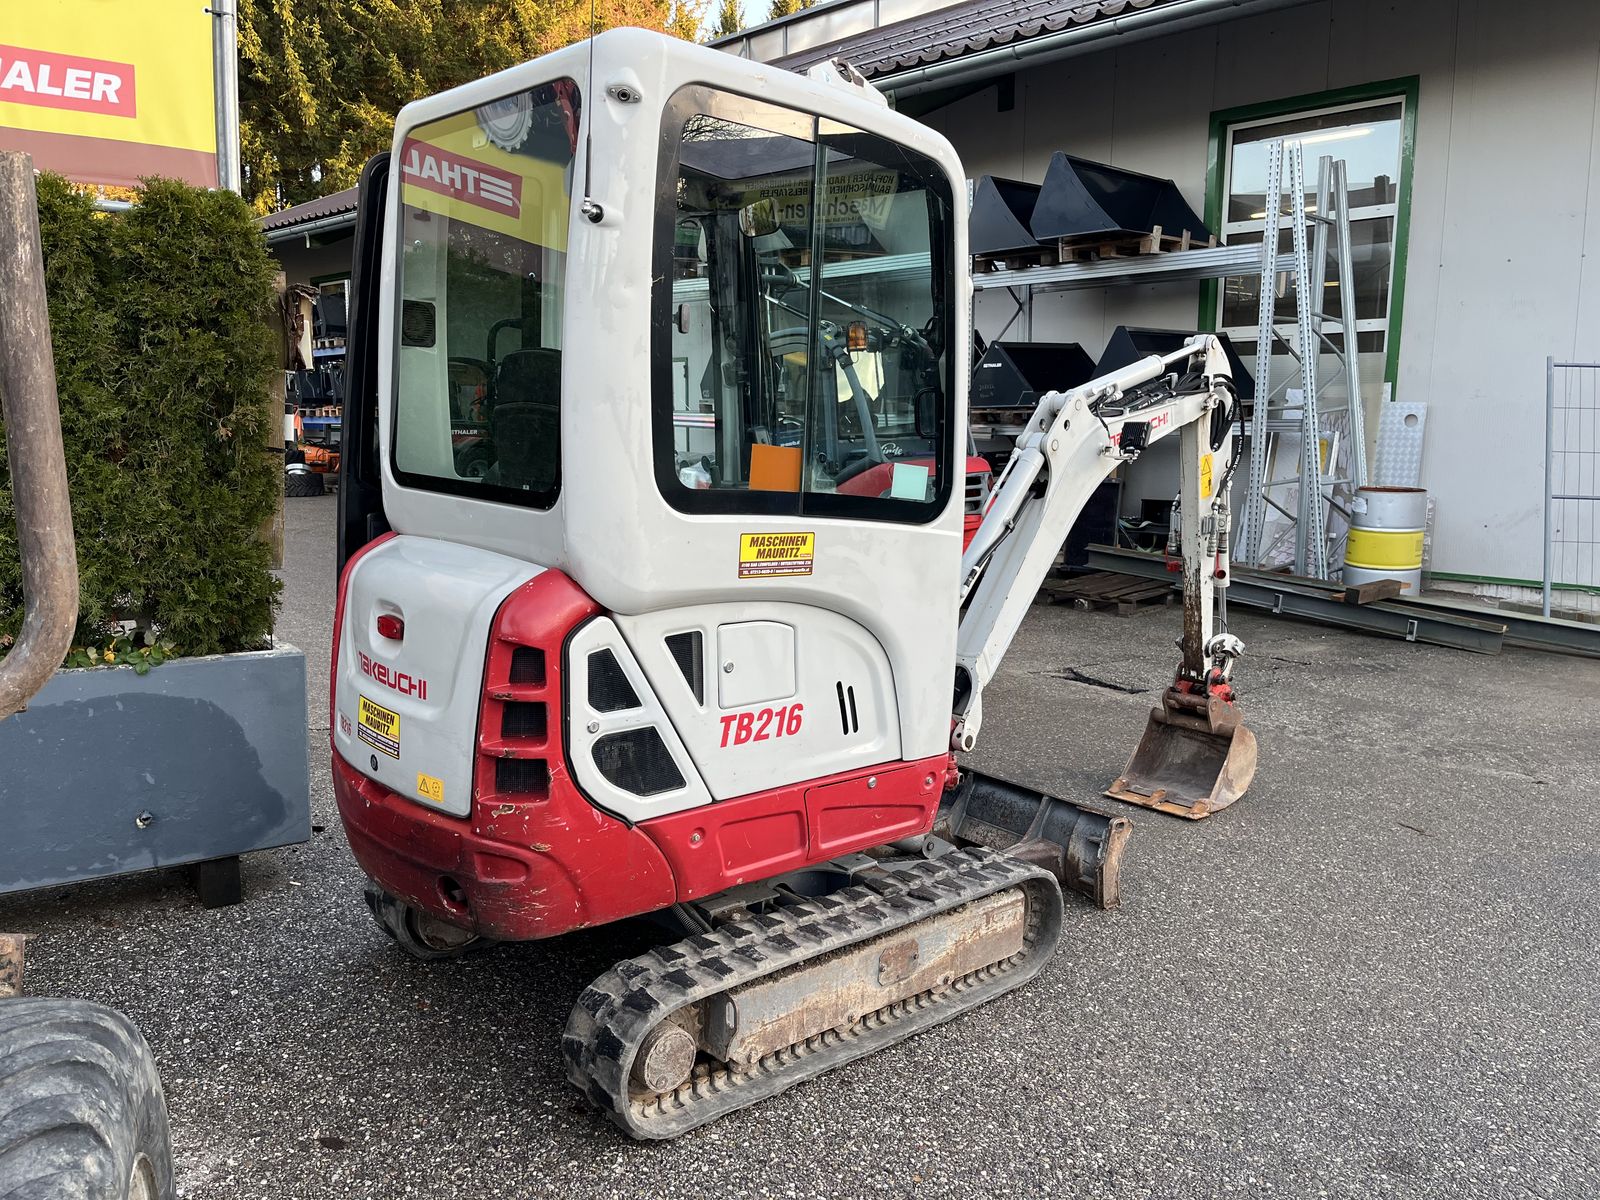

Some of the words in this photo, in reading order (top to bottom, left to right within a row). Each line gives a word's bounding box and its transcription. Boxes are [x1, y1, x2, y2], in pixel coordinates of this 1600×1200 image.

[0, 57, 122, 104] ALER
[749, 535, 808, 548] MASCHINEN
[756, 547, 801, 559] MAURITZ
[358, 651, 427, 701] TAKEUCHI
[363, 700, 395, 726] MASCHINEN
[365, 714, 390, 736] MAURITZ
[719, 703, 804, 748] TB216
